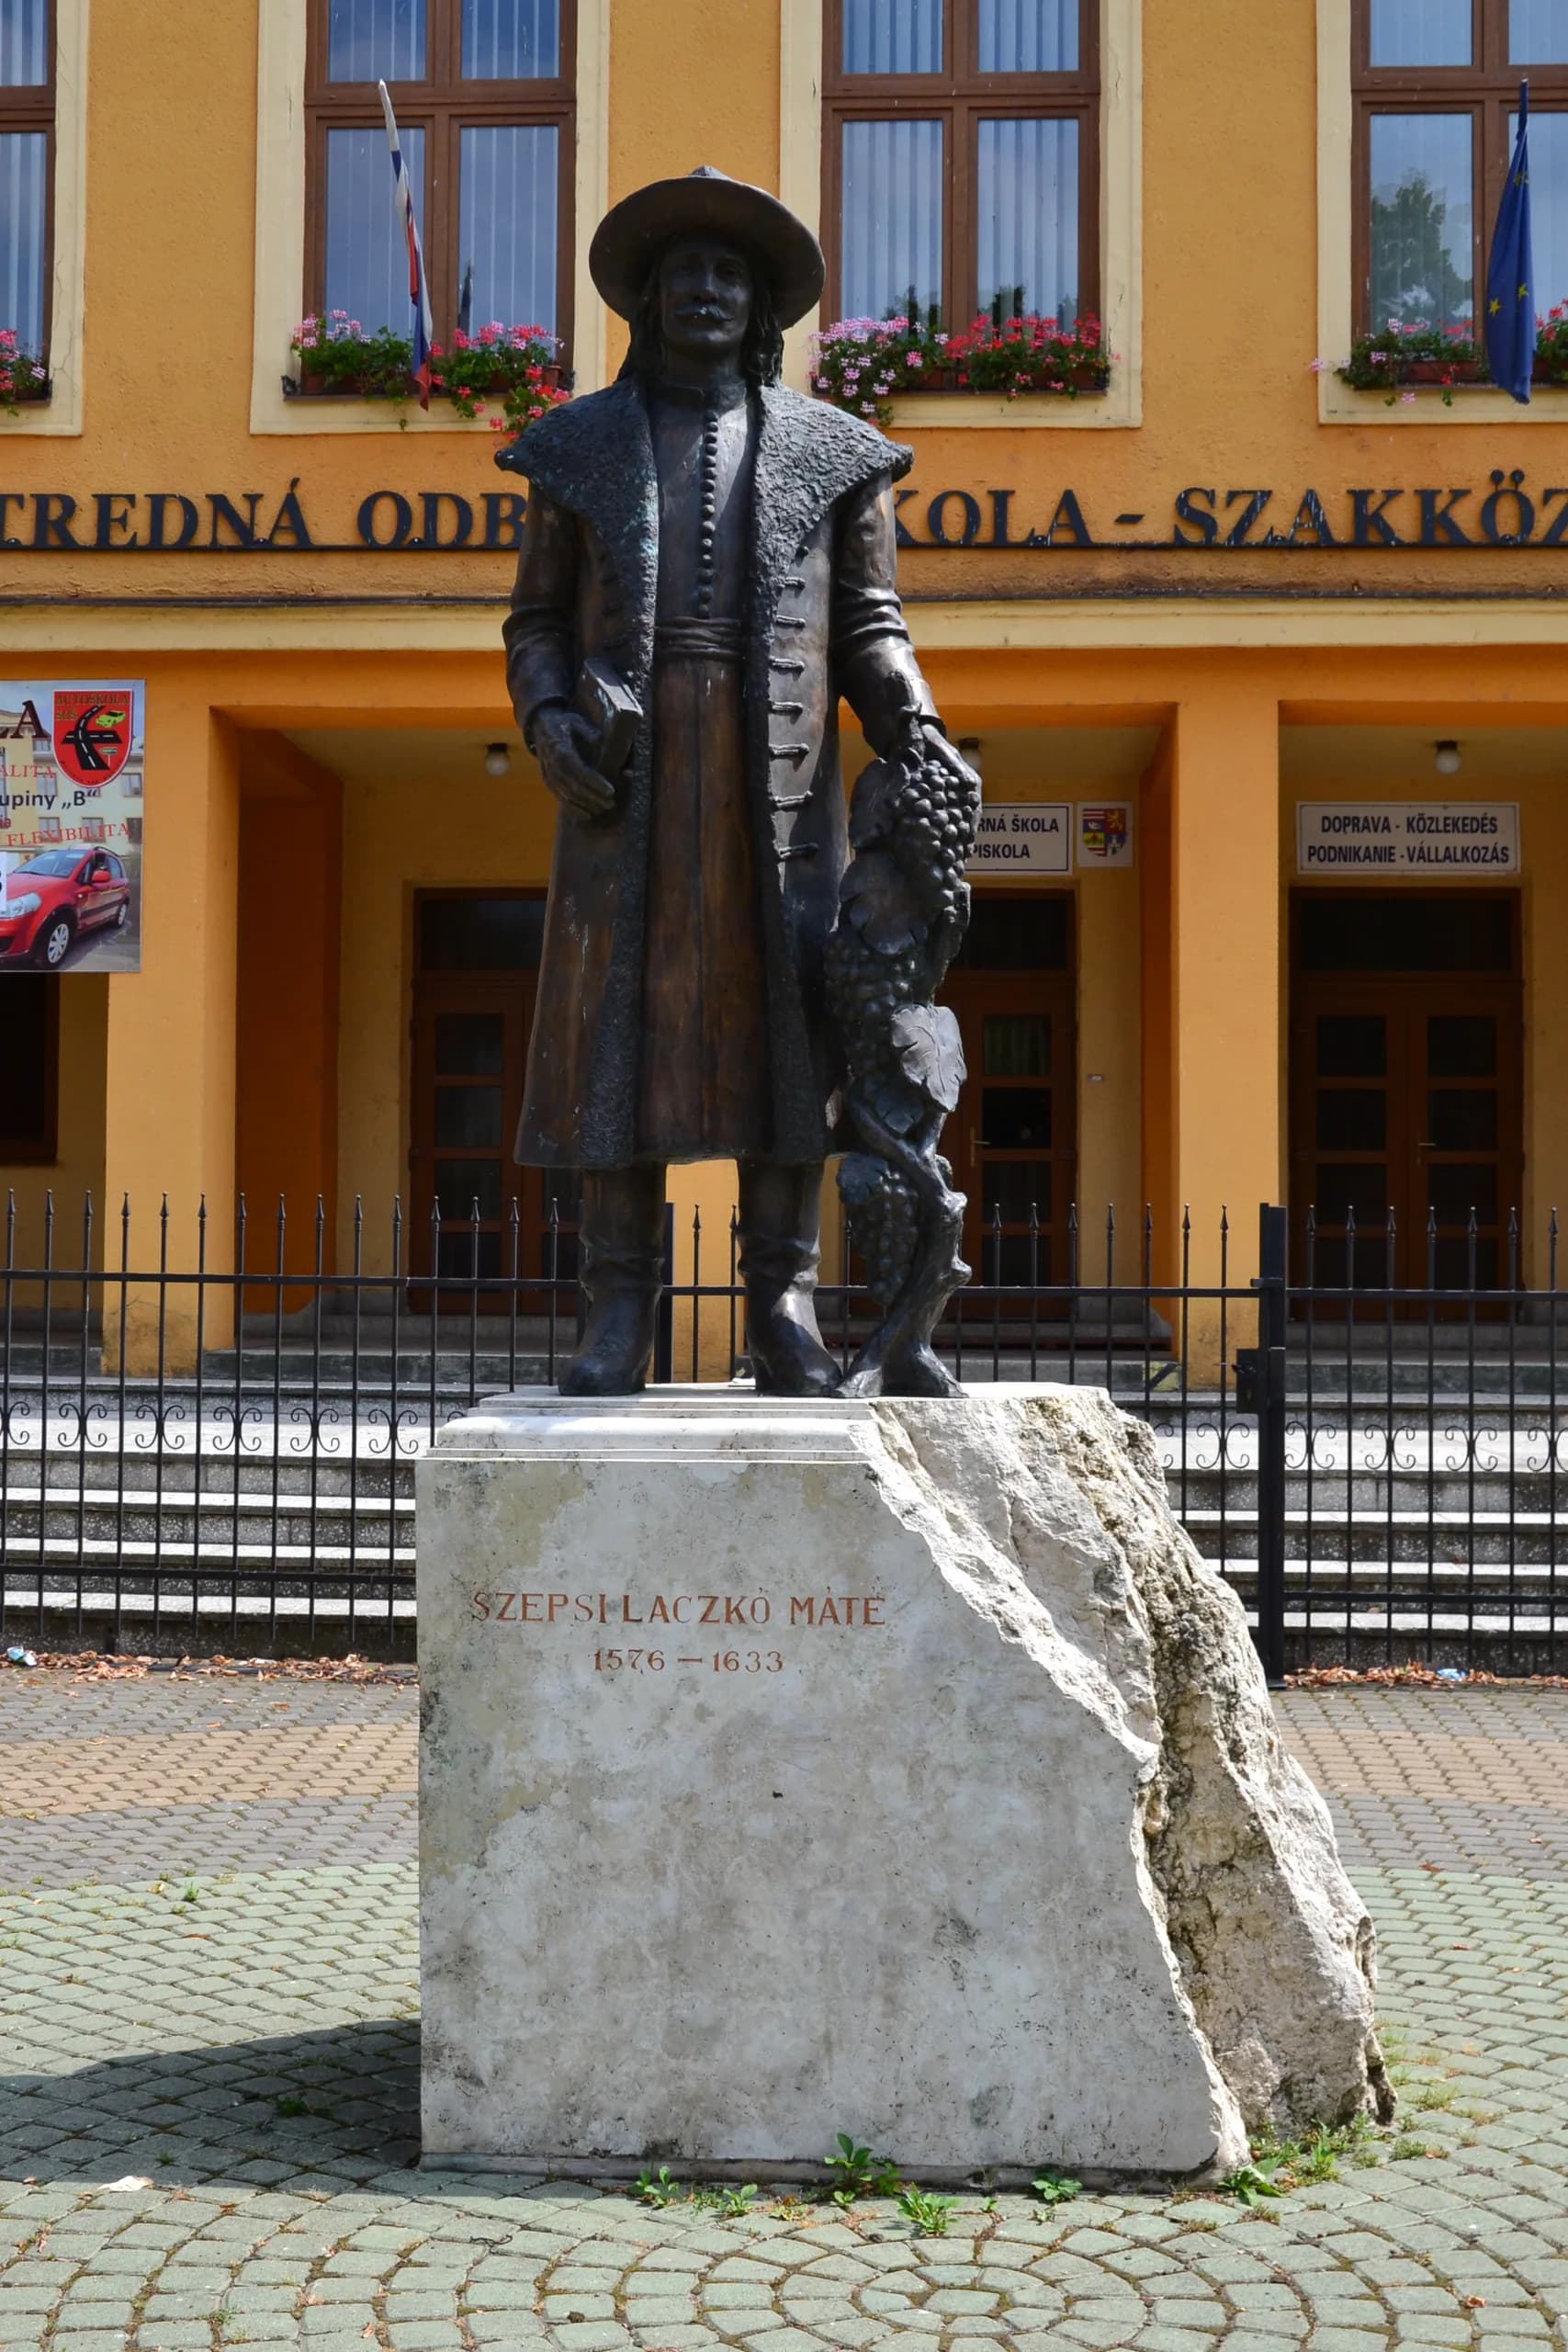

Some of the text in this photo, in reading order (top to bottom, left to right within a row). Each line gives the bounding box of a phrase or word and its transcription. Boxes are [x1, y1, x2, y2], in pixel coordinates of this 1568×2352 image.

[356, 490, 525, 548] ODB
[6, 822, 132, 847] FLEXIBILITA
[1011, 813, 1059, 833] ŠKOLA
[1321, 815, 1392, 834] DOPRAVA
[1307, 844, 1396, 864] PODNIKANIE
[1406, 841, 1509, 865] VÁLLALKOZÁS
[471, 1591, 607, 1623] SZEPSI
[622, 1587, 772, 1625] LACZKÓ
[592, 1648, 665, 1673] 1576
[712, 1649, 784, 1674] 1633
